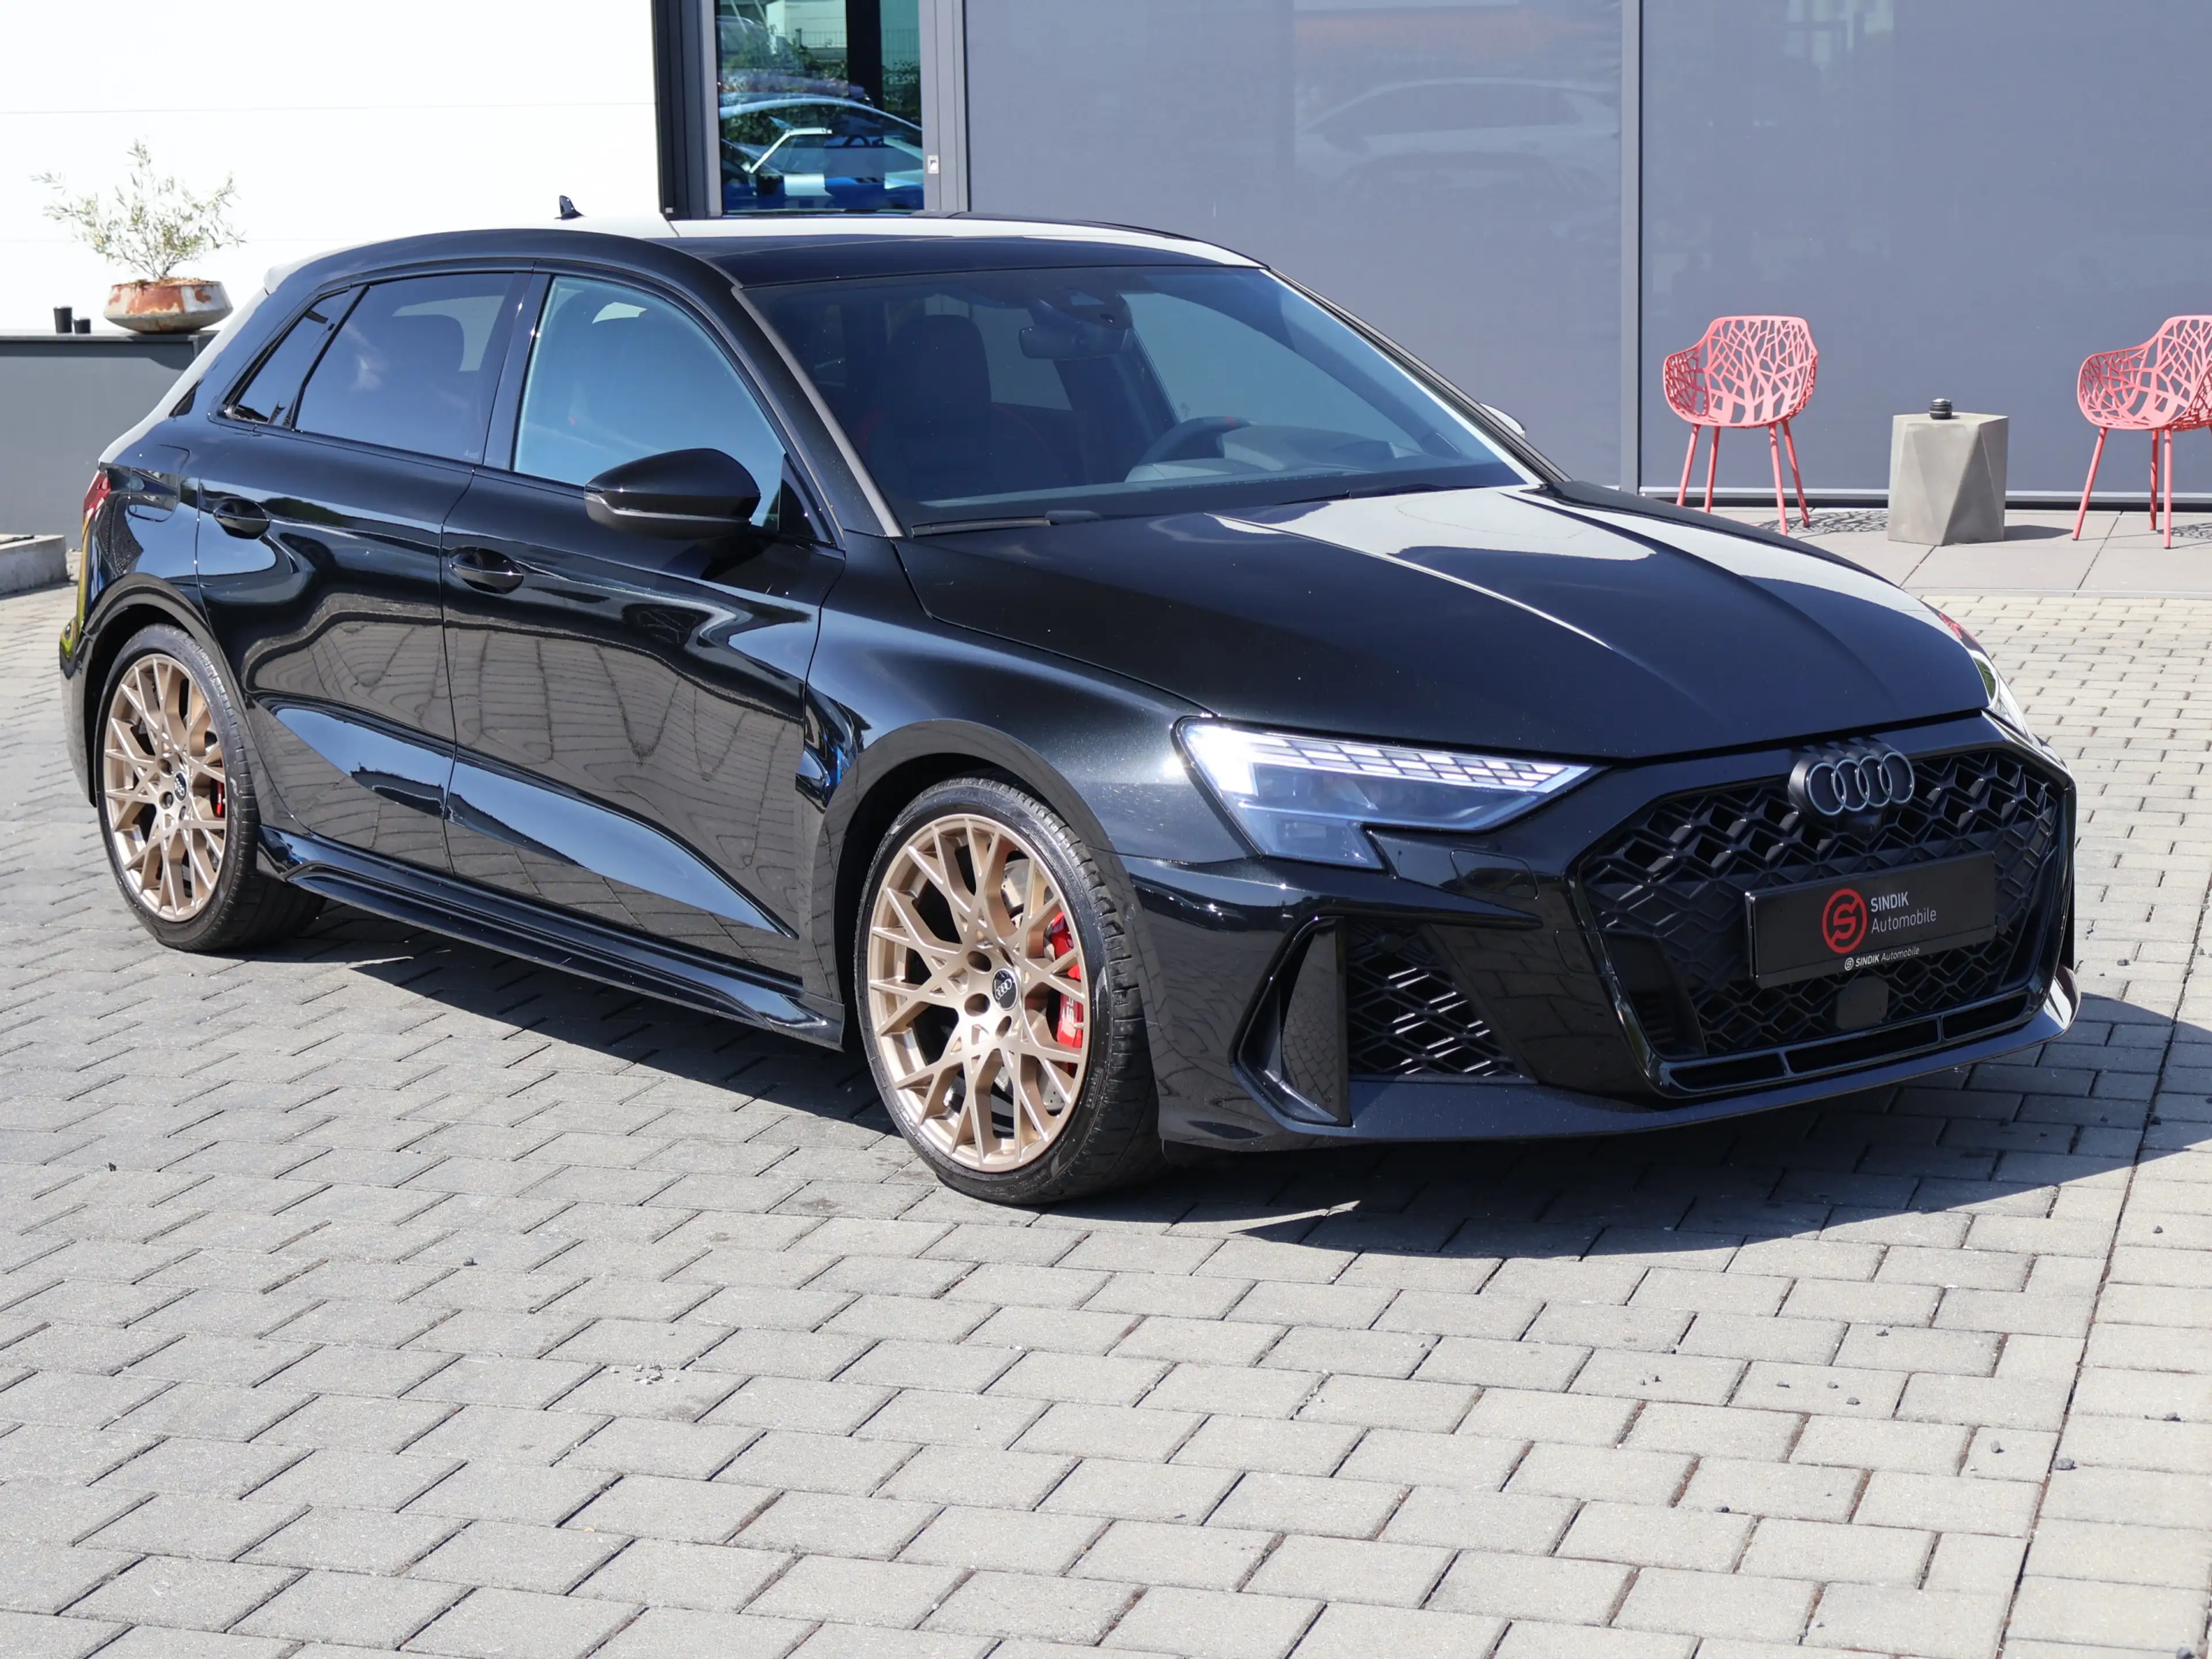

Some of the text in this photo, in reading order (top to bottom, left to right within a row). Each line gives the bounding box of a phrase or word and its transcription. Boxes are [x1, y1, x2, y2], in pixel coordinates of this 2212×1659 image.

[1871, 892, 1909, 912] SINDIK
[1871, 907, 1937, 934] Automobile
[1855, 954, 1880, 967] SINDIK
[1881, 946, 1920, 961] Automobile
